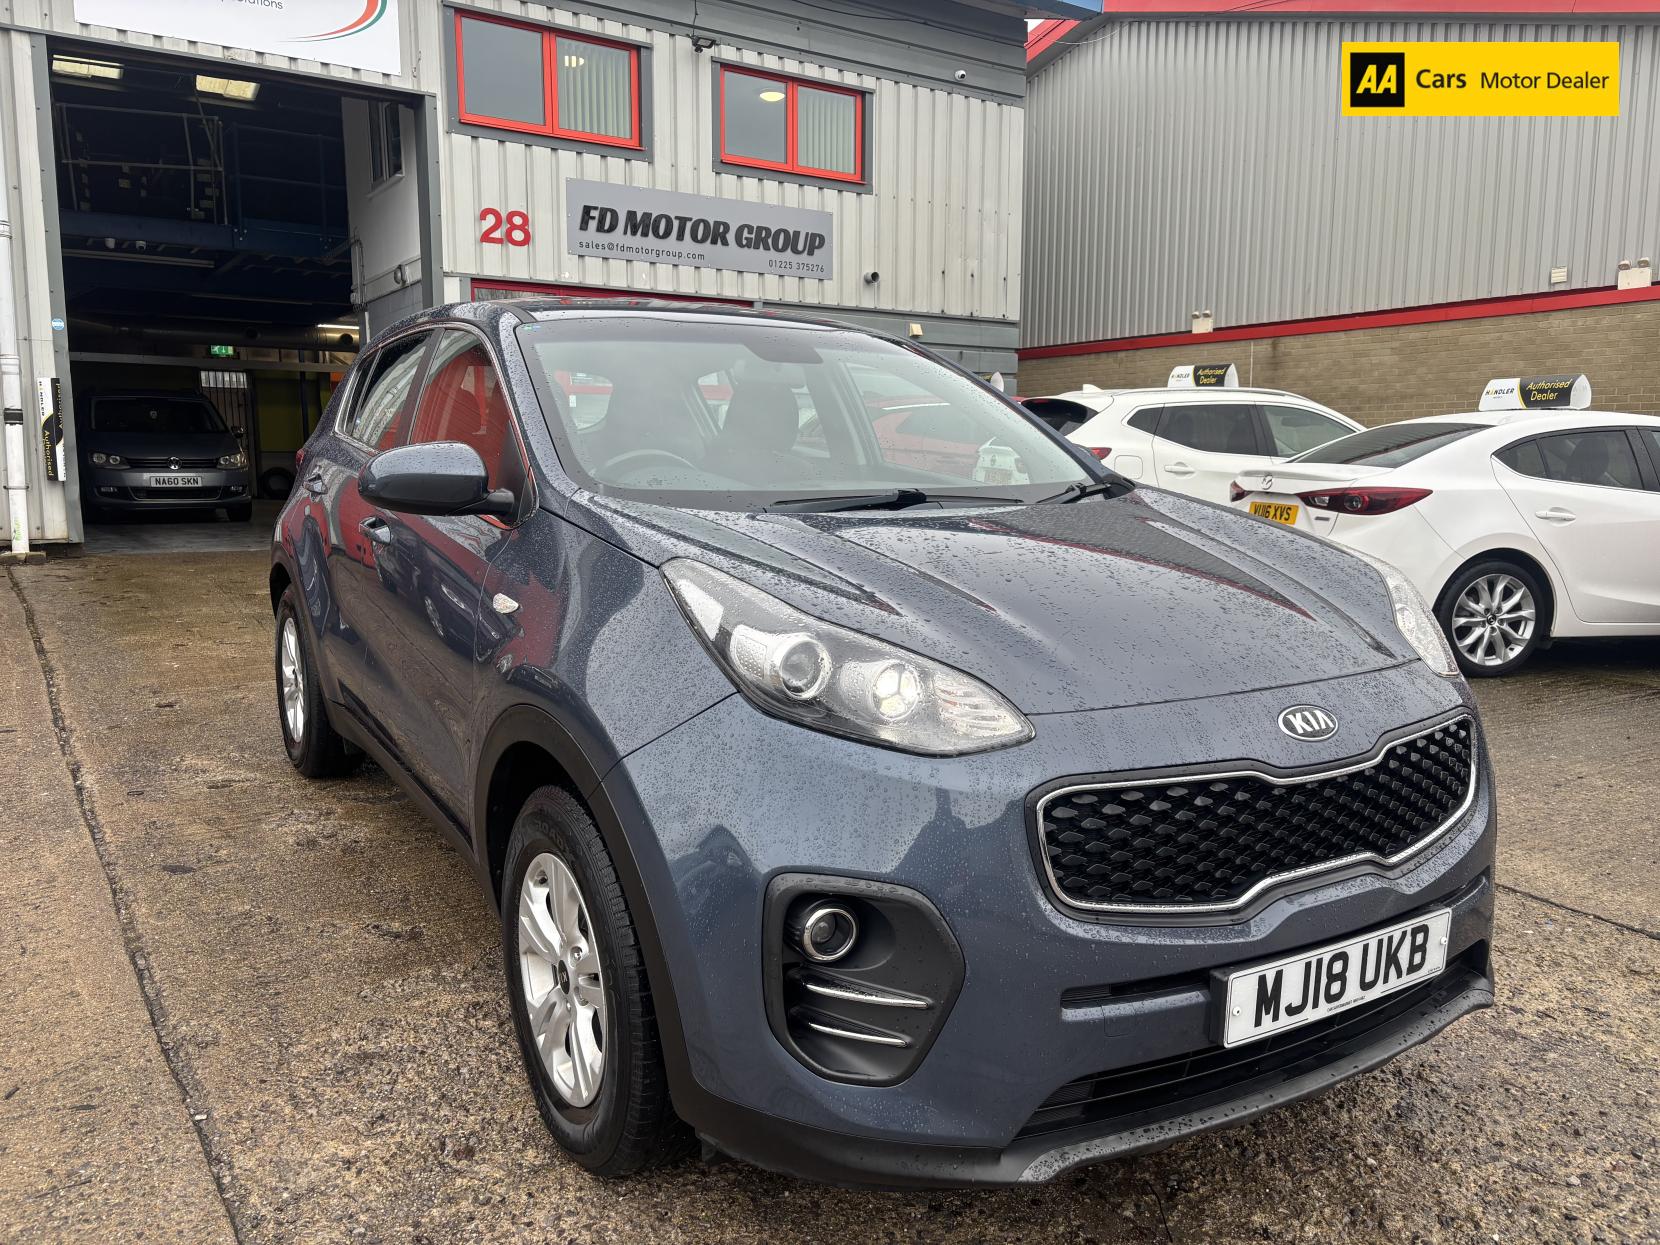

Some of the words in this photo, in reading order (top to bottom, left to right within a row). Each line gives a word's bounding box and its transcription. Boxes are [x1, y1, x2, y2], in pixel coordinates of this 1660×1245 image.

[479, 207, 532, 247] 28
[578, 205, 620, 234] FD
[622, 209, 731, 247] MOTOR
[734, 223, 826, 257] GROUP
[578, 240, 705, 261] sales@fdmotorgroup.com
[768, 259, 793, 270] 01225
[796, 262, 825, 273] 375276
[1526, 379, 1573, 391] Authorised
[1530, 390, 1558, 401] Dealer
[155, 477, 179, 486] NA60
[181, 477, 199, 486] SKN
[1271, 505, 1292, 522] XVS
[1285, 709, 1335, 734] KIA
[1254, 951, 1350, 1028] MJ18
[1359, 923, 1430, 992] UKB
